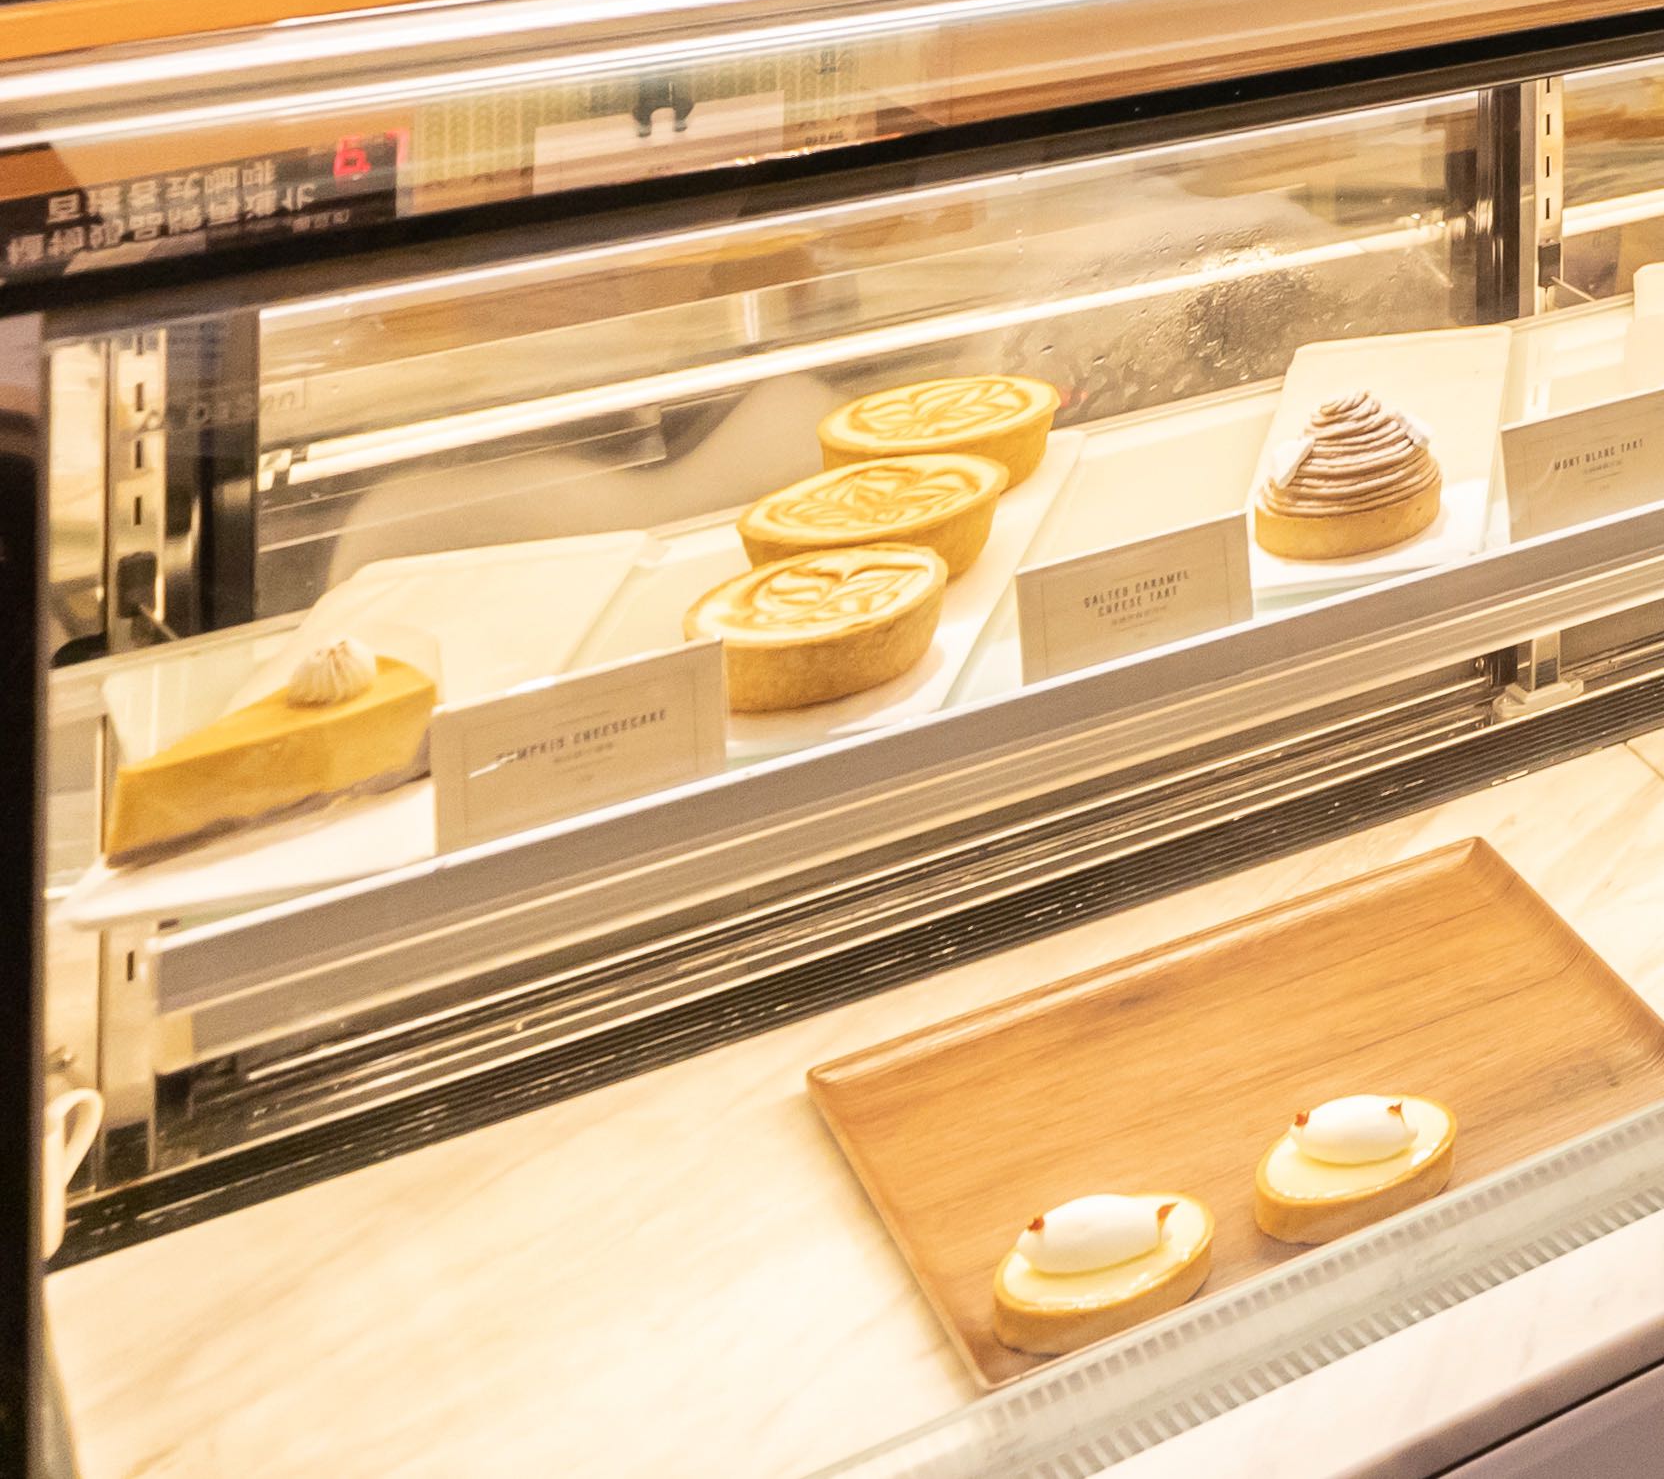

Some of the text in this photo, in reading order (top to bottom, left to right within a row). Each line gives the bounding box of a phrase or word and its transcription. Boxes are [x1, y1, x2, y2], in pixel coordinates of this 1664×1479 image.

[1554, 456, 1580, 471] MONT
[1586, 447, 1615, 463] BLANC
[1621, 438, 1643, 452] TART
[1084, 570, 1190, 608] SALTED CARAMEL
[1098, 596, 1142, 617] CHEESE
[1151, 585, 1178, 601] TART
[573, 709, 667, 744] CHEESECAKE
